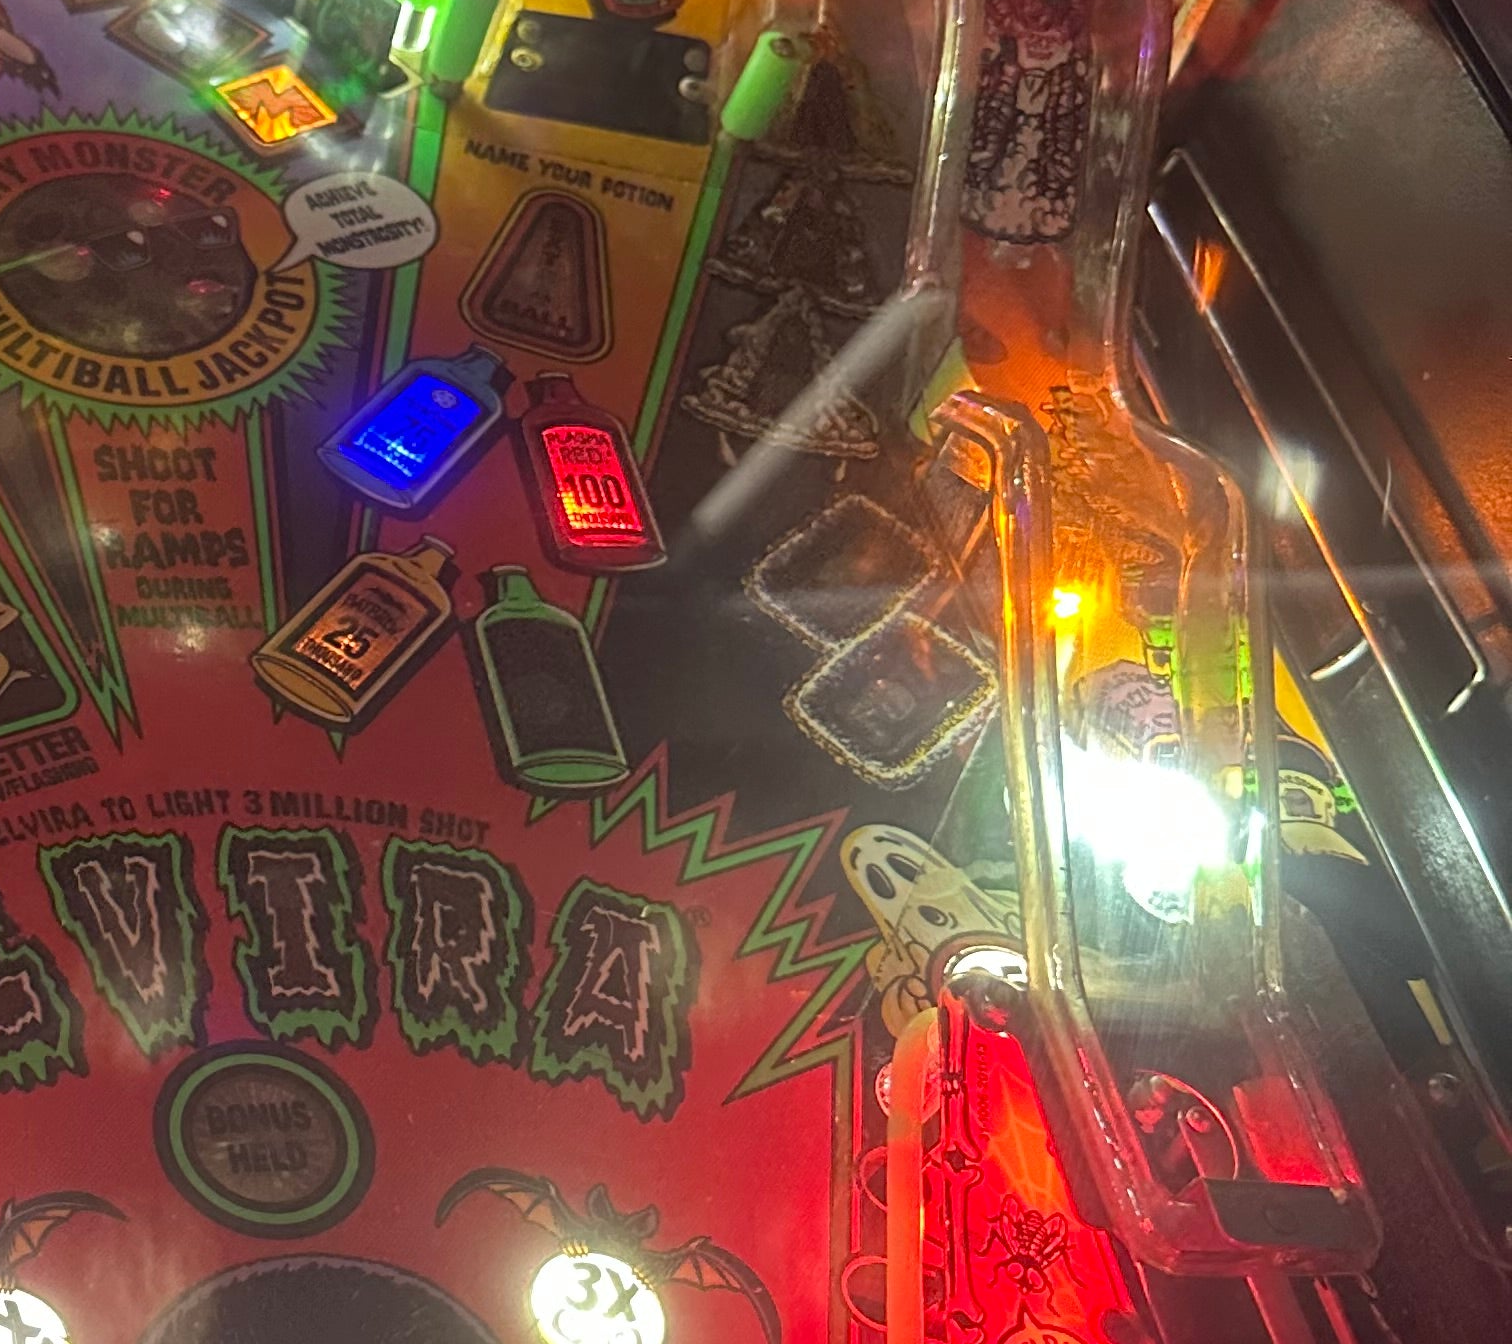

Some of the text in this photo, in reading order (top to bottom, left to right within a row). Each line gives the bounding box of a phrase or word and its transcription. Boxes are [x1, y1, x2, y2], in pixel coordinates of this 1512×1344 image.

[28, 141, 237, 206] MONSTER
[464, 138, 676, 212] NAME YOUR POTION
[330, 205, 384, 230] TOTAL
[197, 269, 307, 393] JACKPOT
[93, 443, 218, 483] SHOOT
[129, 488, 205, 526] FOR
[564, 473, 625, 508] 100
[102, 527, 251, 570] RAMPS
[320, 616, 381, 660] 25
[101, 795, 137, 822] TO
[146, 788, 230, 820] LIGHT
[243, 789, 264, 816] 3
[269, 789, 409, 830] MILLION
[418, 807, 492, 845] SHOT
[205, 1101, 312, 1137] BONUS
[226, 1142, 309, 1175] HELD
[565, 1261, 640, 1324] 3X
